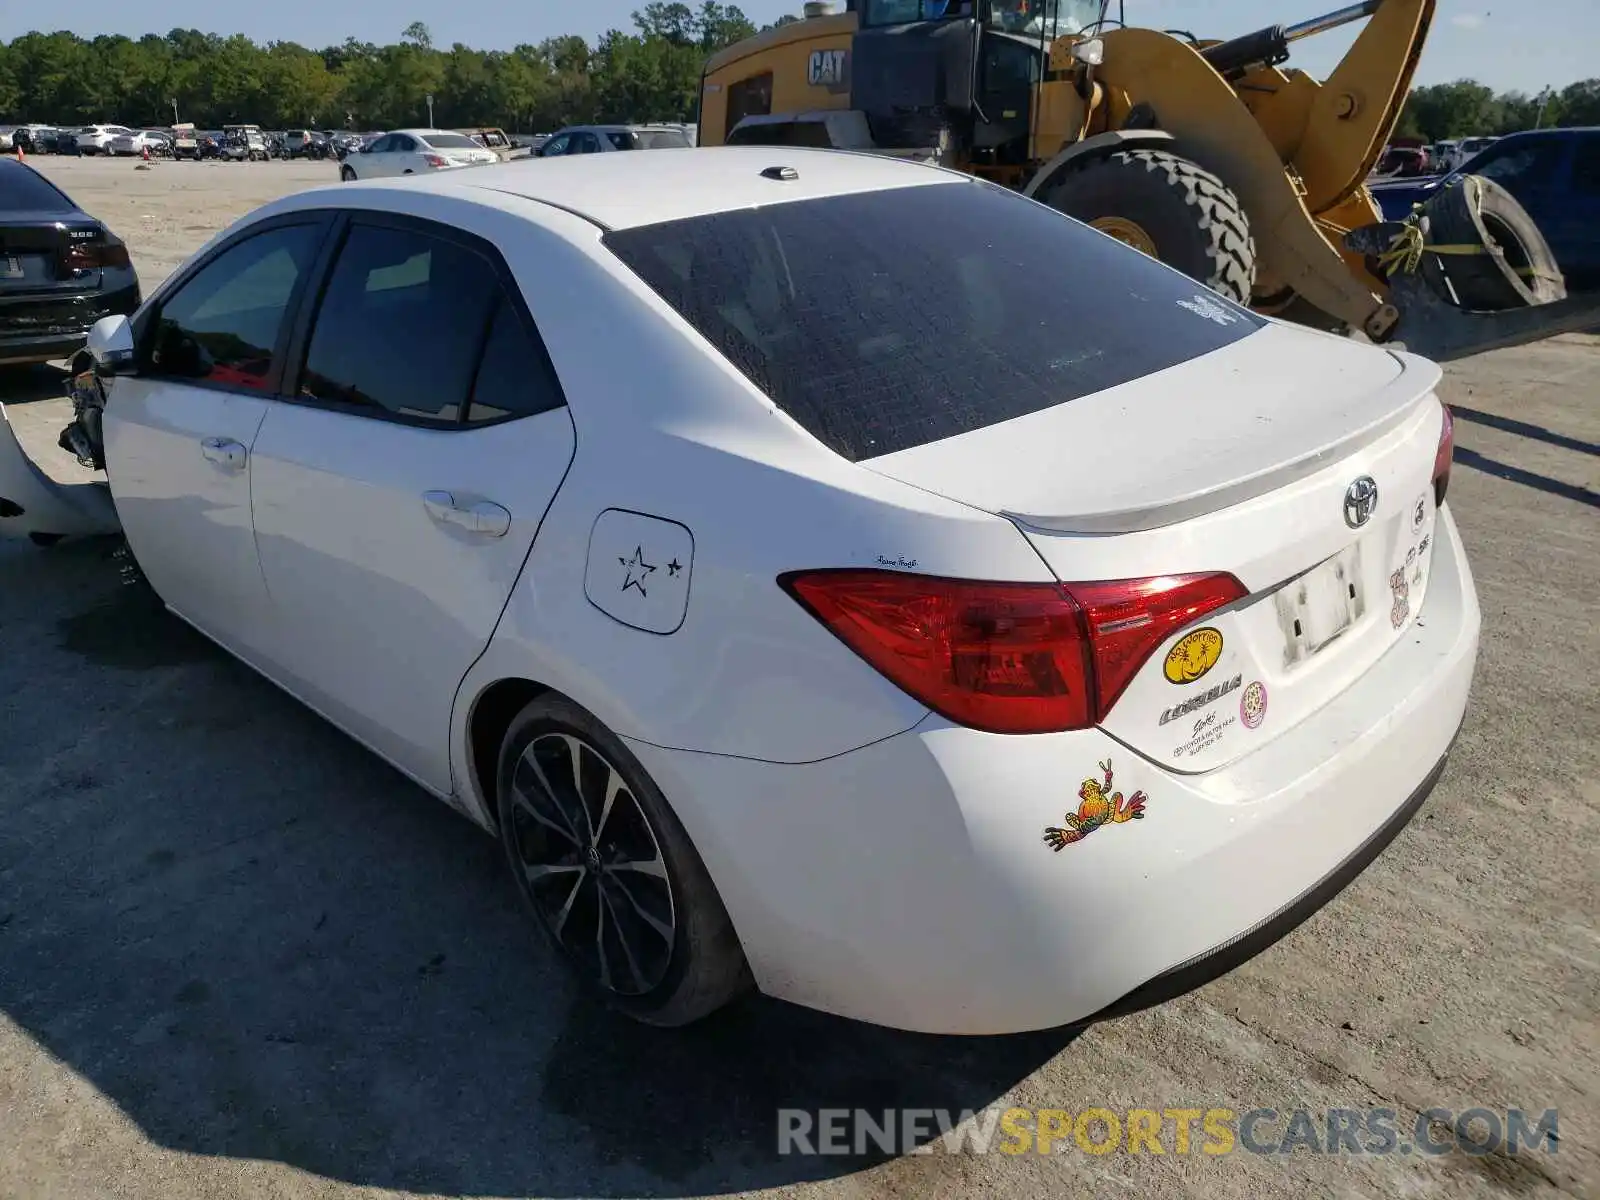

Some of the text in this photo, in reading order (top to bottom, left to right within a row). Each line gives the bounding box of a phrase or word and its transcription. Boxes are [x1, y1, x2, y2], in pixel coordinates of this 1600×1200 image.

[808, 50, 845, 85] CAT
[1183, 632, 1217, 648] Worries
[1159, 673, 1243, 727] COROLLA
